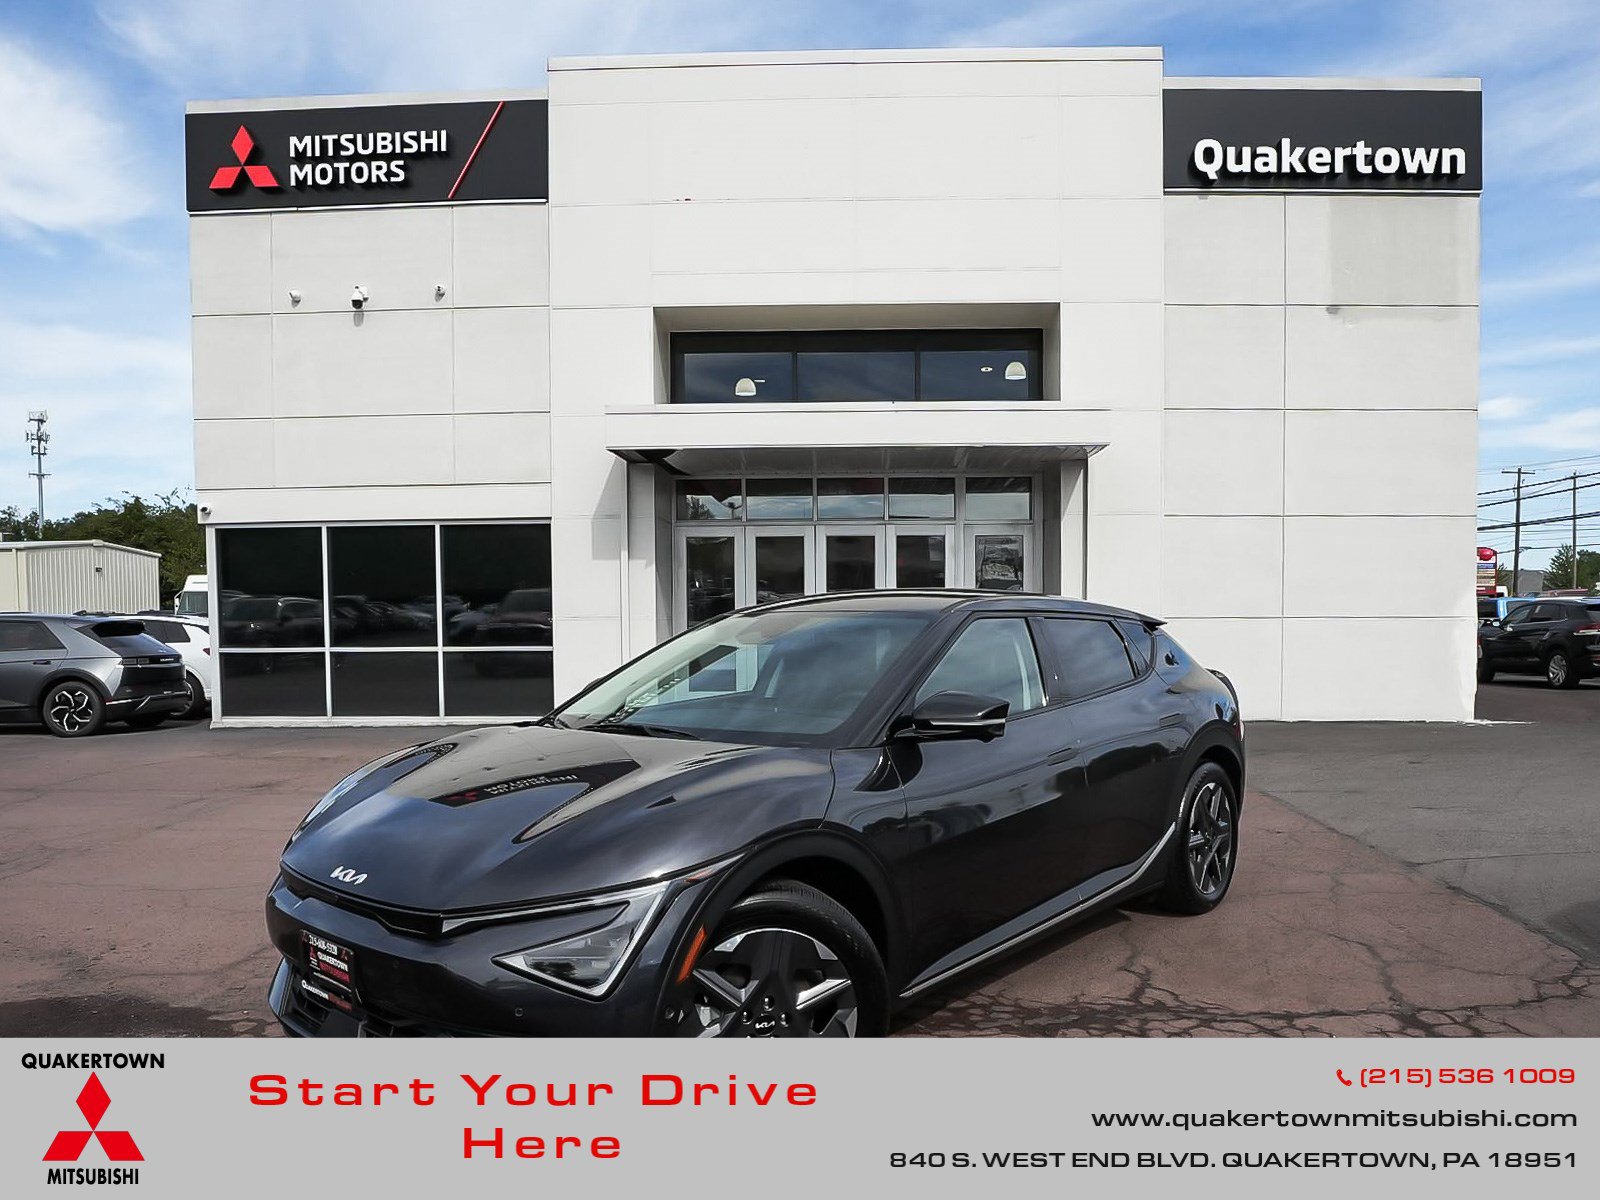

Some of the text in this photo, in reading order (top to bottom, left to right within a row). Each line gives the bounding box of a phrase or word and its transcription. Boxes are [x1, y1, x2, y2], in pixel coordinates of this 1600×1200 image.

[289, 129, 448, 158] MITSUBISHI
[1193, 137, 1467, 181] Quakertown
[289, 160, 405, 187] MOTORS
[329, 865, 368, 886] KIA
